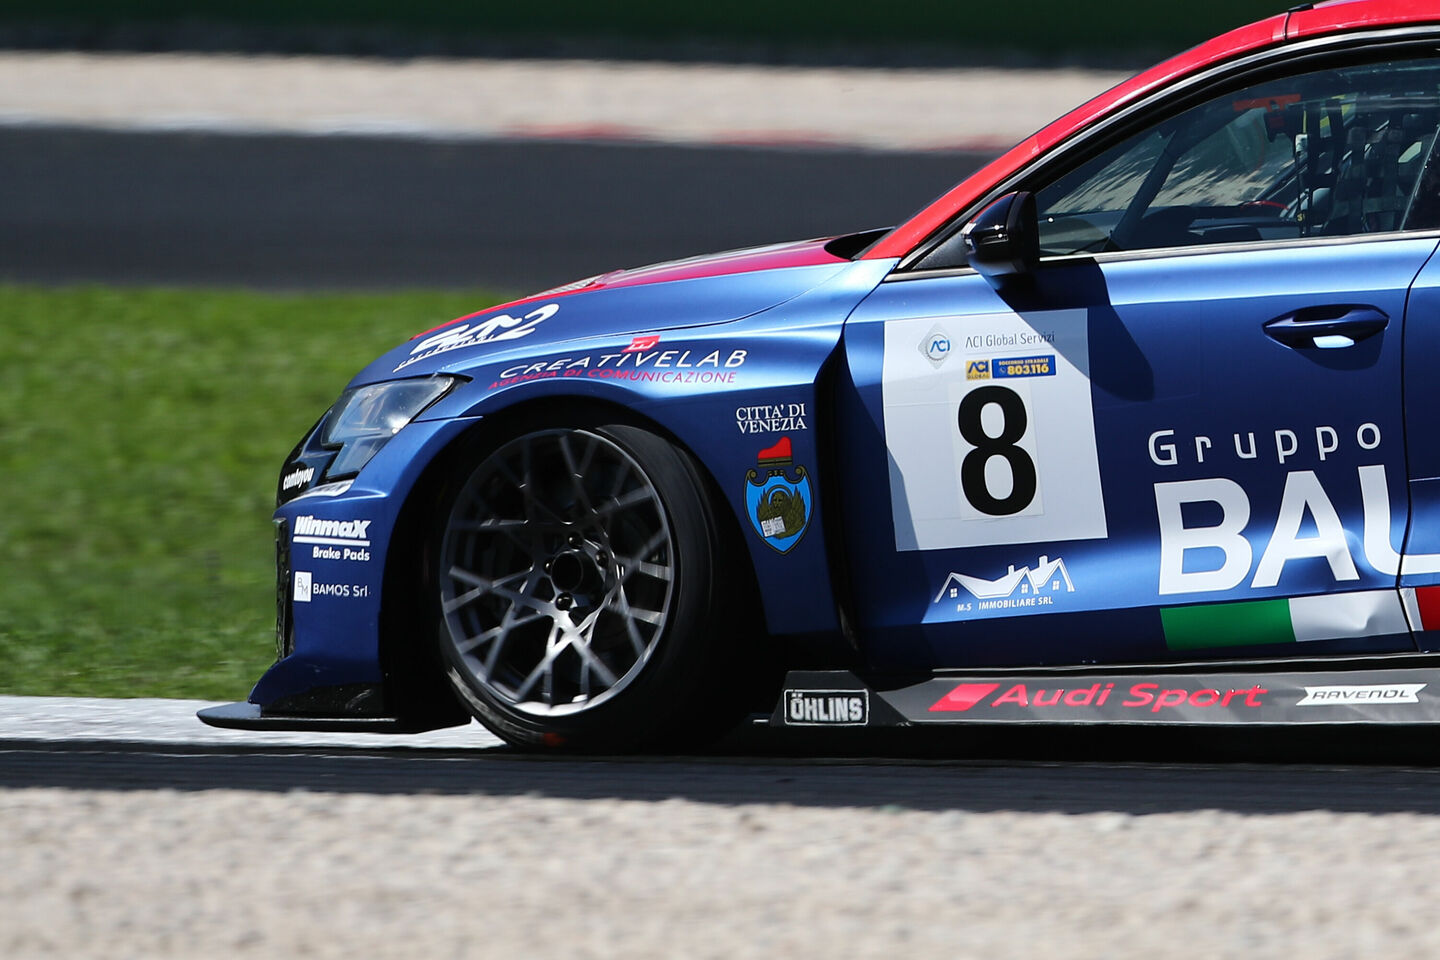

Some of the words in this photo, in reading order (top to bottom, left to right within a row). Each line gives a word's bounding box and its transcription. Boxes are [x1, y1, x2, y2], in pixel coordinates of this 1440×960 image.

[930, 340, 951, 352] ACI
[965, 336, 983, 349] ACI
[986, 334, 1017, 347] Global
[1020, 331, 1056, 344] Servizi
[500, 349, 749, 379] CREATIVELAB
[967, 360, 990, 373] ACI
[488, 370, 557, 390] AGENZIA
[562, 369, 583, 377] DI
[587, 368, 737, 384] COMUNICAZIONE
[736, 404, 785, 421] CITTA'
[789, 403, 807, 417] DI
[737, 417, 808, 434] VENEZIA
[958, 385, 1037, 516] 8
[1147, 422, 1381, 466] Gruppo
[312, 546, 341, 560] Brake
[343, 548, 370, 561] Pads
[312, 584, 350, 597] BAMOS
[978, 598, 1036, 611] IMMOBILIARE
[1037, 596, 1053, 606] SRL
[990, 682, 1115, 708] Audi
[1122, 682, 1269, 713] Sport
[1311, 689, 1411, 700] RAVENOL
[790, 692, 863, 722] ÖHLINS
